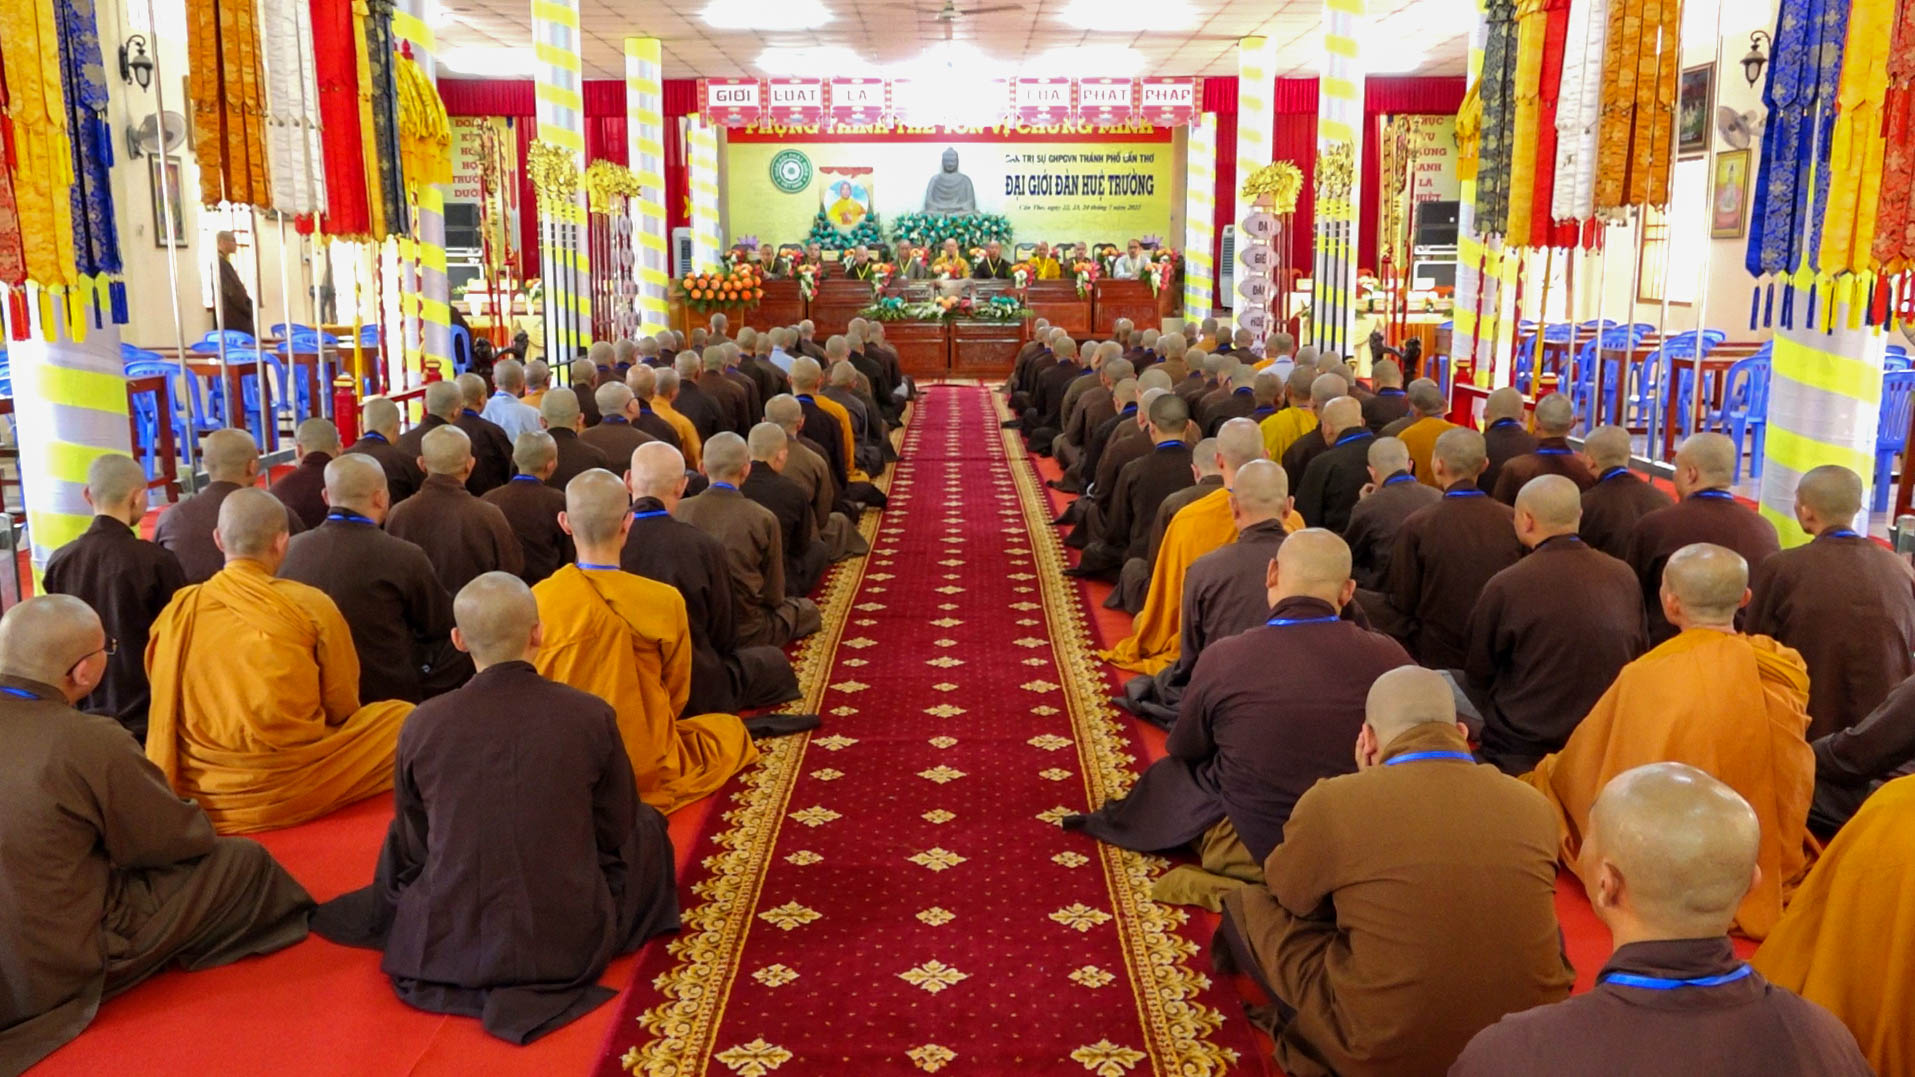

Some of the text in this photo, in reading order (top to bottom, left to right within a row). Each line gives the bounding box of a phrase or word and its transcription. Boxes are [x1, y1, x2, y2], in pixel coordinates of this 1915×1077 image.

[1005, 174, 1026, 201] ĐẠI
[1028, 168, 1053, 196] GIỚI
[1055, 168, 1080, 196] ĐÀN
[1107, 168, 1155, 196] TRƯỜNG
